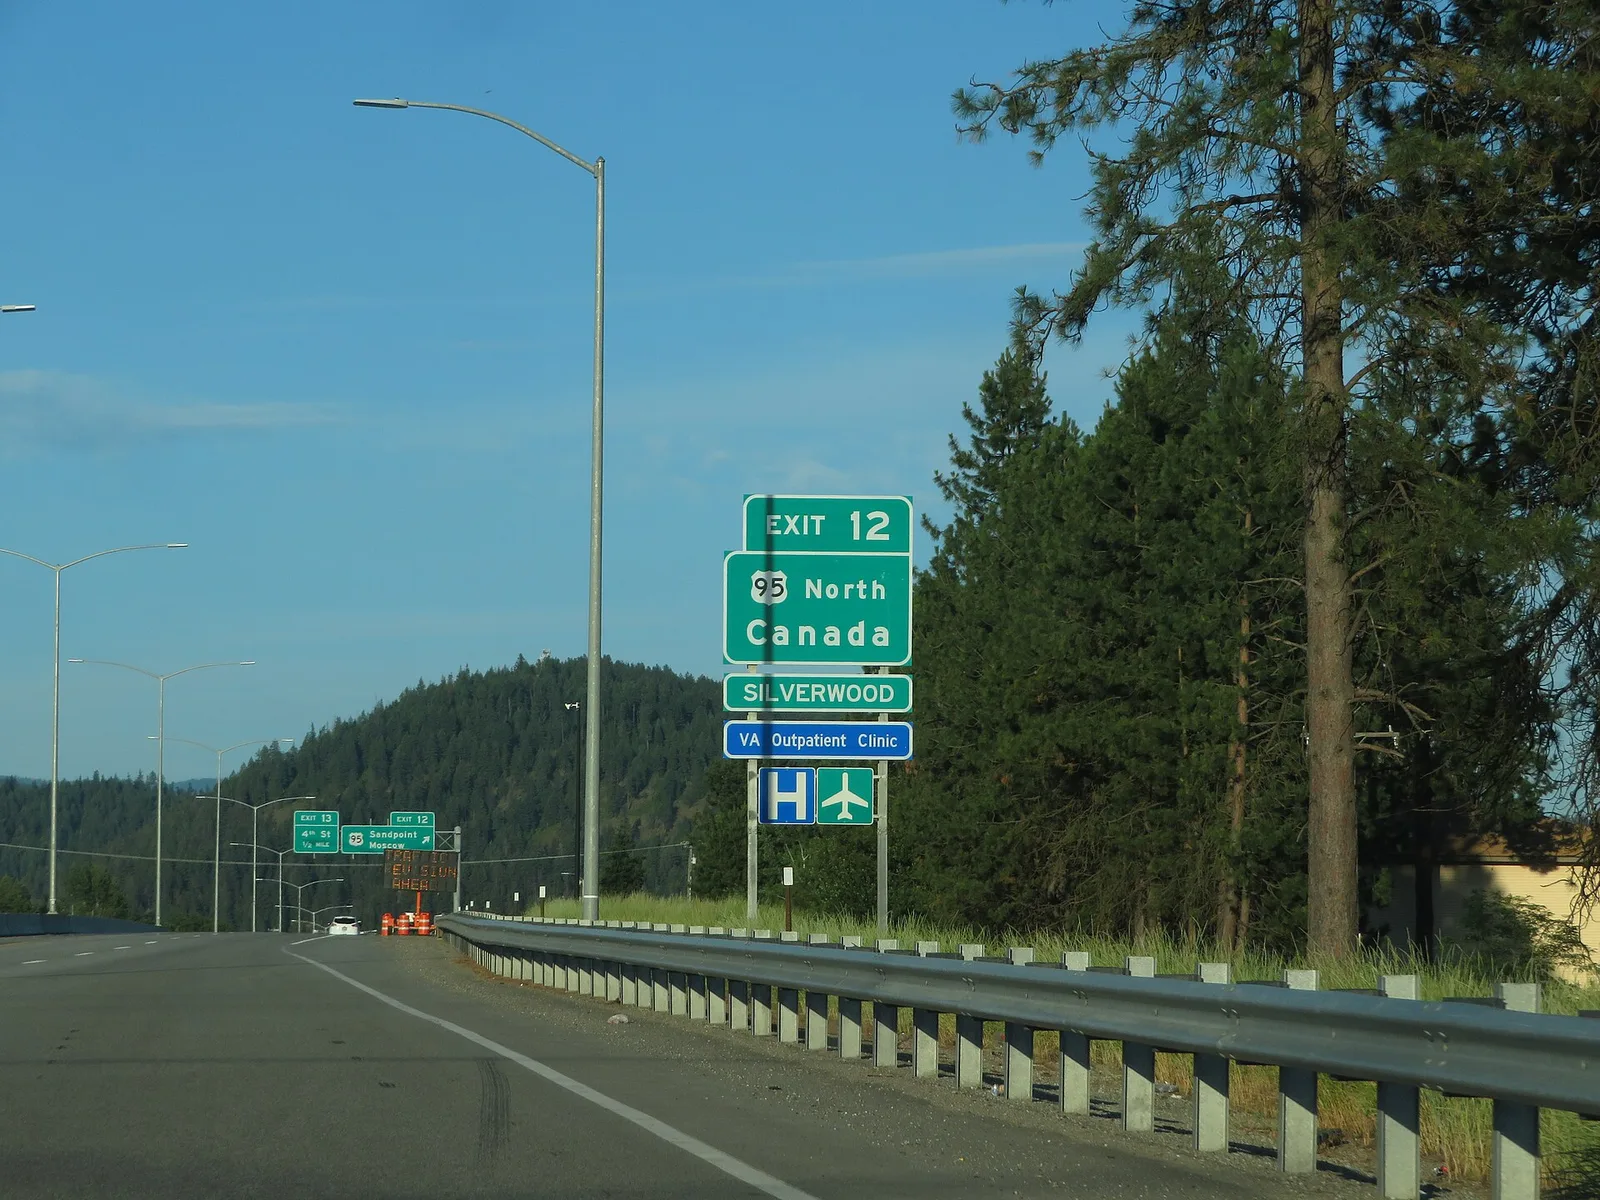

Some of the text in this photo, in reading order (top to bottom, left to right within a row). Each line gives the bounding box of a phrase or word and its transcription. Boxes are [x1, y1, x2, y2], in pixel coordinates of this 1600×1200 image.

[766, 511, 890, 541] EXIT 12
[754, 577, 886, 600] 95 North
[746, 619, 889, 647] Canada
[743, 683, 895, 703] SILVERWOOD
[739, 733, 898, 751] VA Outpatient Clinic
[767, 771, 807, 820] H
[321, 814, 332, 823] 13
[417, 815, 429, 824] 12
[320, 830, 331, 838] St
[350, 835, 362, 844] 95
[369, 830, 418, 839] Sandpoint
[385, 850, 448, 863] TRAFIC
[384, 863, 457, 878] REVSION
[392, 877, 438, 891] AHEA
